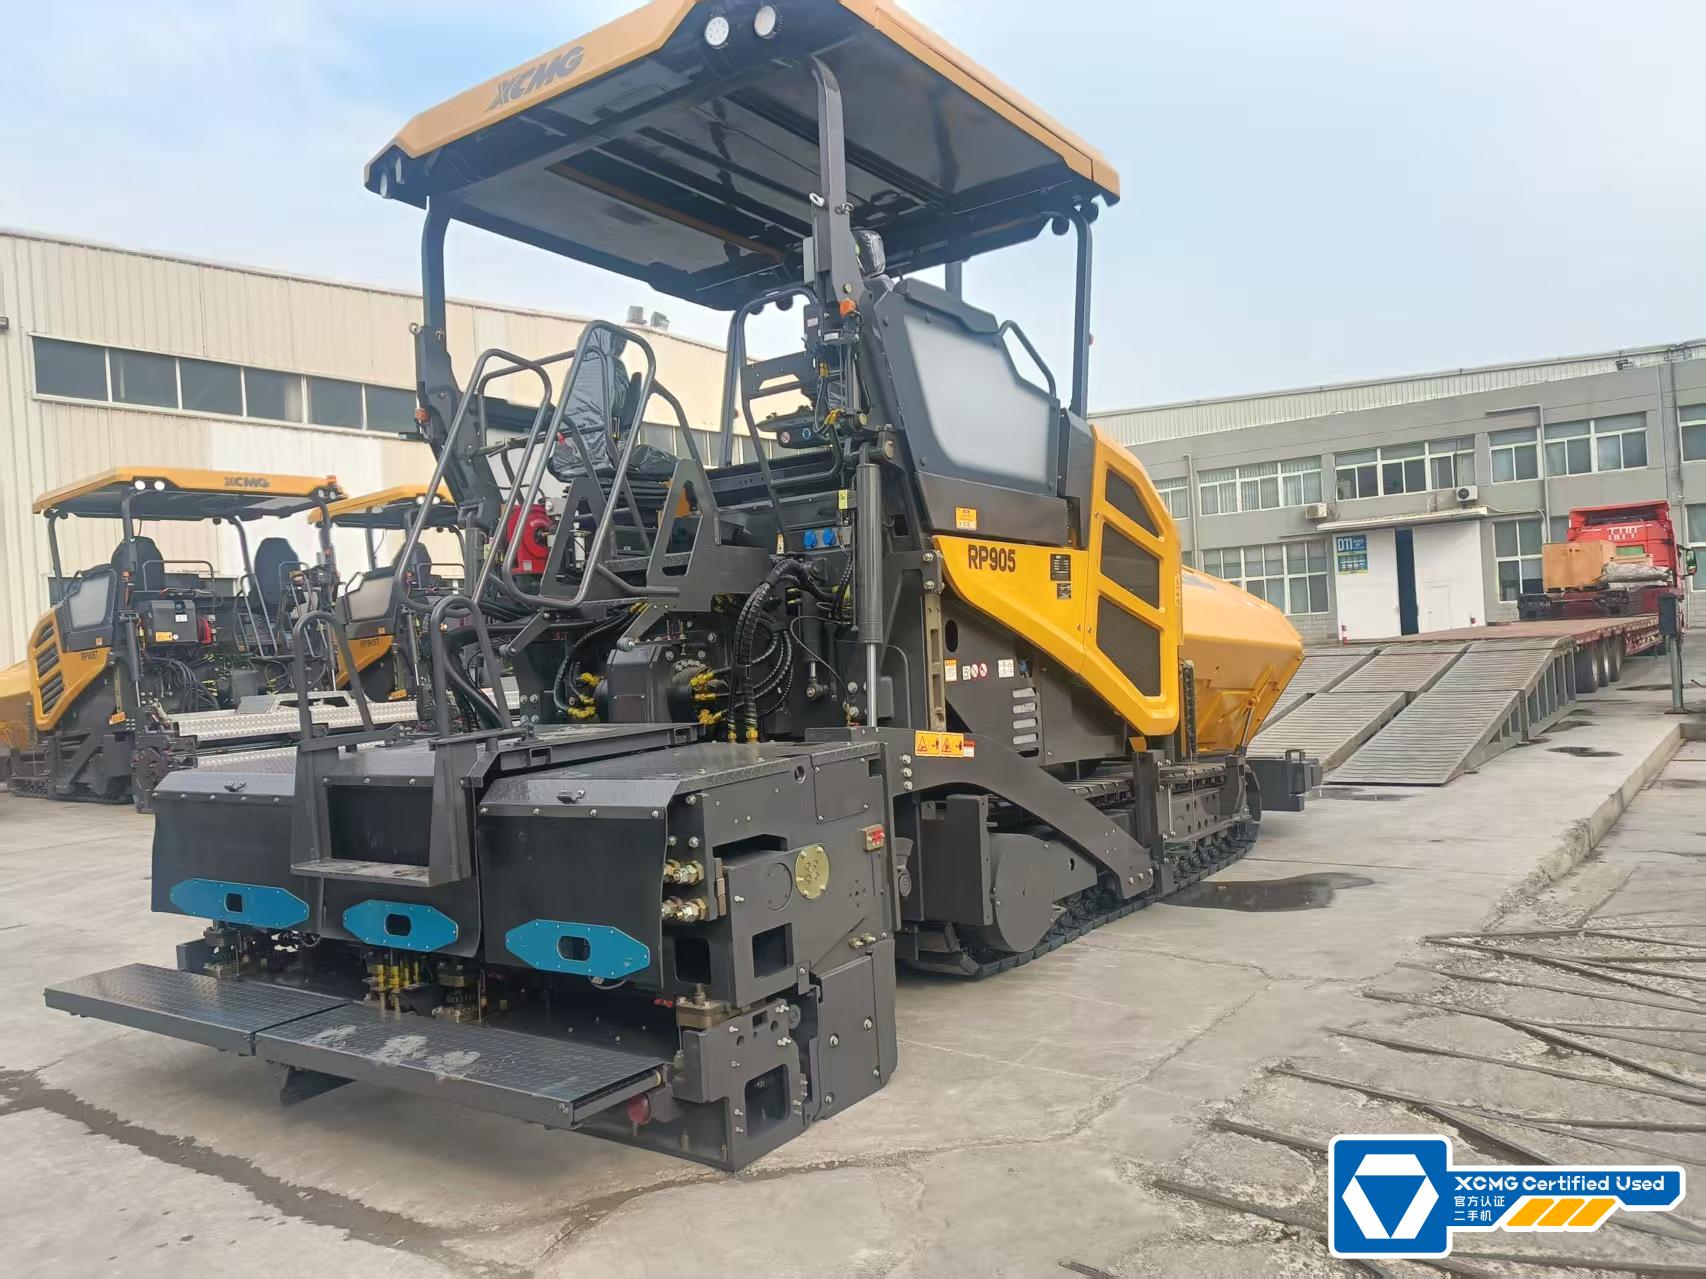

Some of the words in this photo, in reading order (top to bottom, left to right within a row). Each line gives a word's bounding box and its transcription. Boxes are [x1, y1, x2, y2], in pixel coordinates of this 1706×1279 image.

[484, 46, 584, 112] XCMG
[224, 476, 270, 488] XCMG
[968, 544, 1016, 573] RP905
